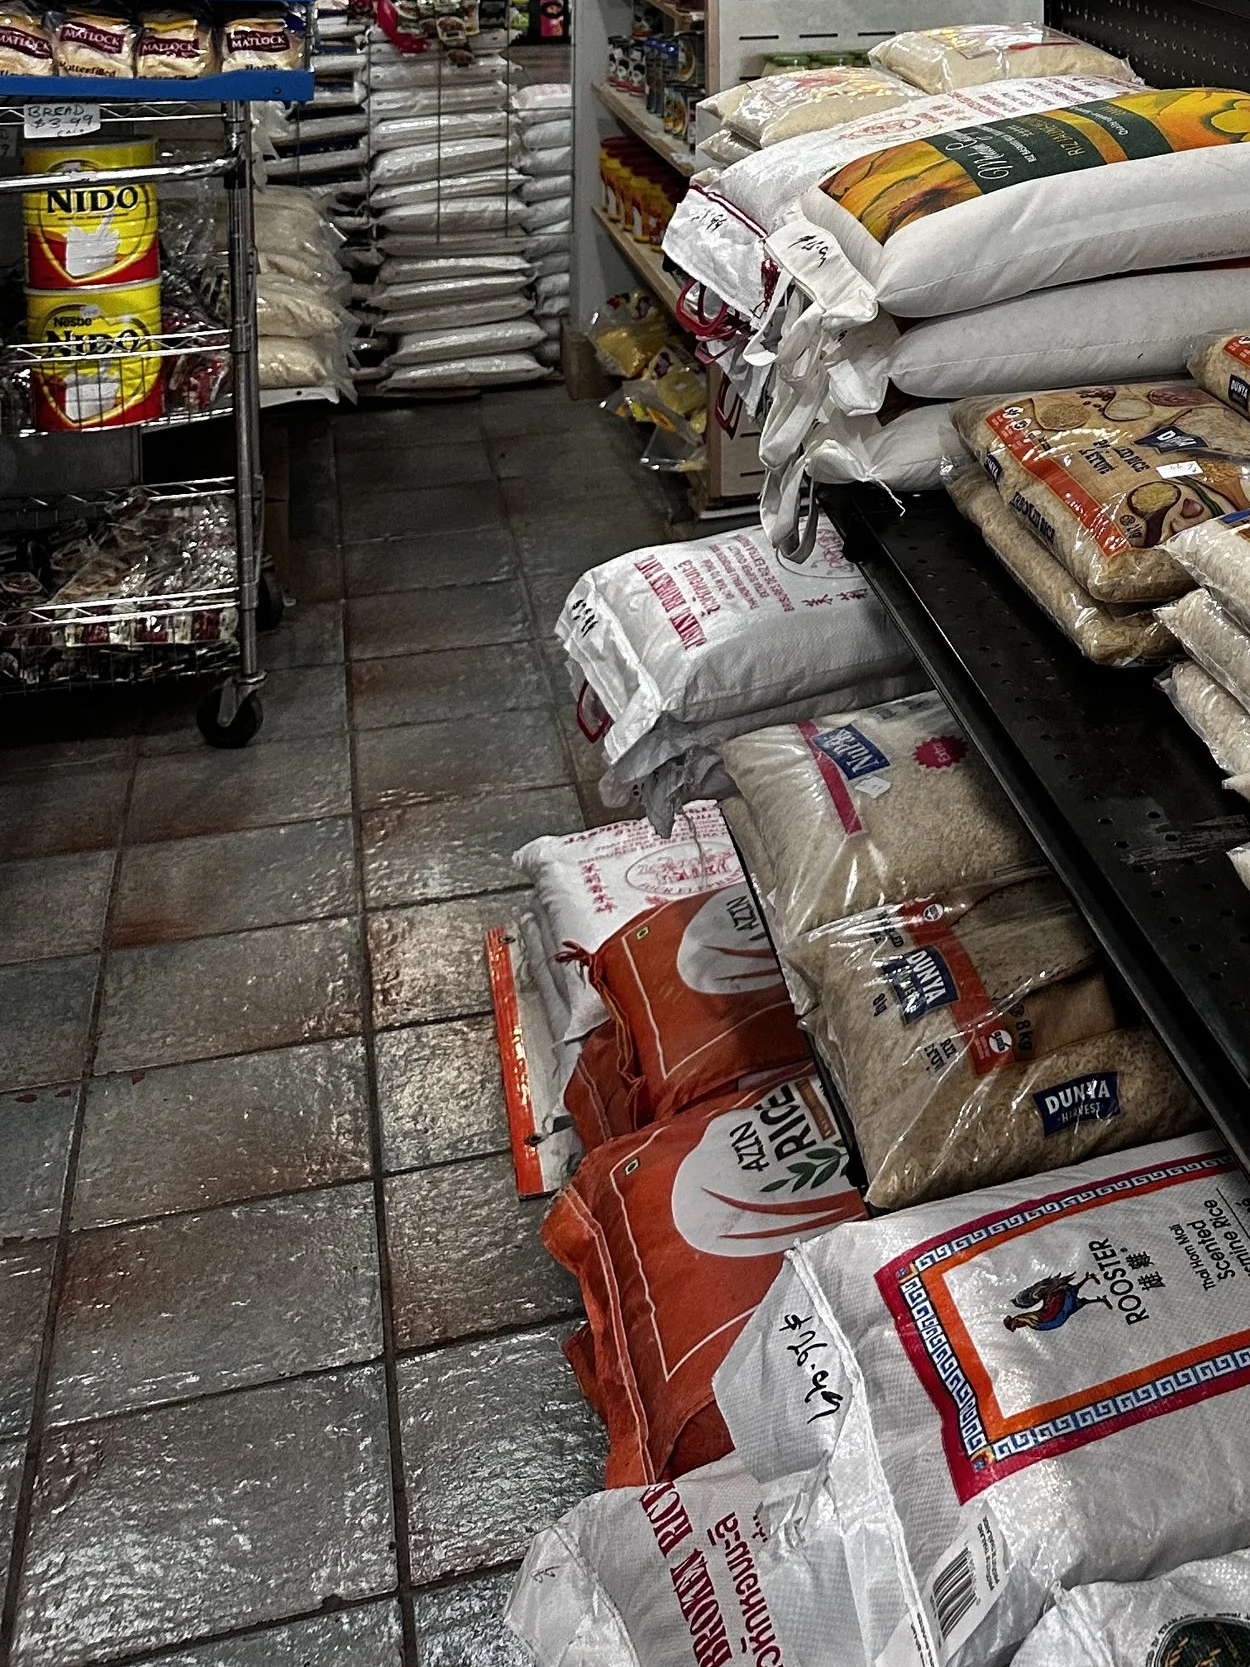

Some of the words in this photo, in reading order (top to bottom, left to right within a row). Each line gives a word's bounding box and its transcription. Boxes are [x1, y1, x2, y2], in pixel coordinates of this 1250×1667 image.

[64, 29, 120, 45] MATLOCK
[232, 36, 285, 48] MATLOCK
[28, 106, 84, 117] BREAD
[47, 187, 139, 213] NIDO
[1230, 379, 1249, 400] DUNYA
[932, 740, 950, 763] Extra
[905, 948, 947, 1005] DUNYA
[1044, 1078, 1111, 1115] DUNYA
[754, 1083, 818, 1162] RICE
[1060, 1102, 1102, 1124] HARVEST
[729, 1120, 770, 1173] AZIN
[1203, 1199, 1232, 1230] Rice
[1168, 1223, 1190, 1247] Mali
[1184, 1245, 1204, 1275] Hom
[1186, 1219, 1236, 1282] Scented
[1088, 1237, 1150, 1326] ROOSTER
[639, 1481, 694, 1559] RICE
